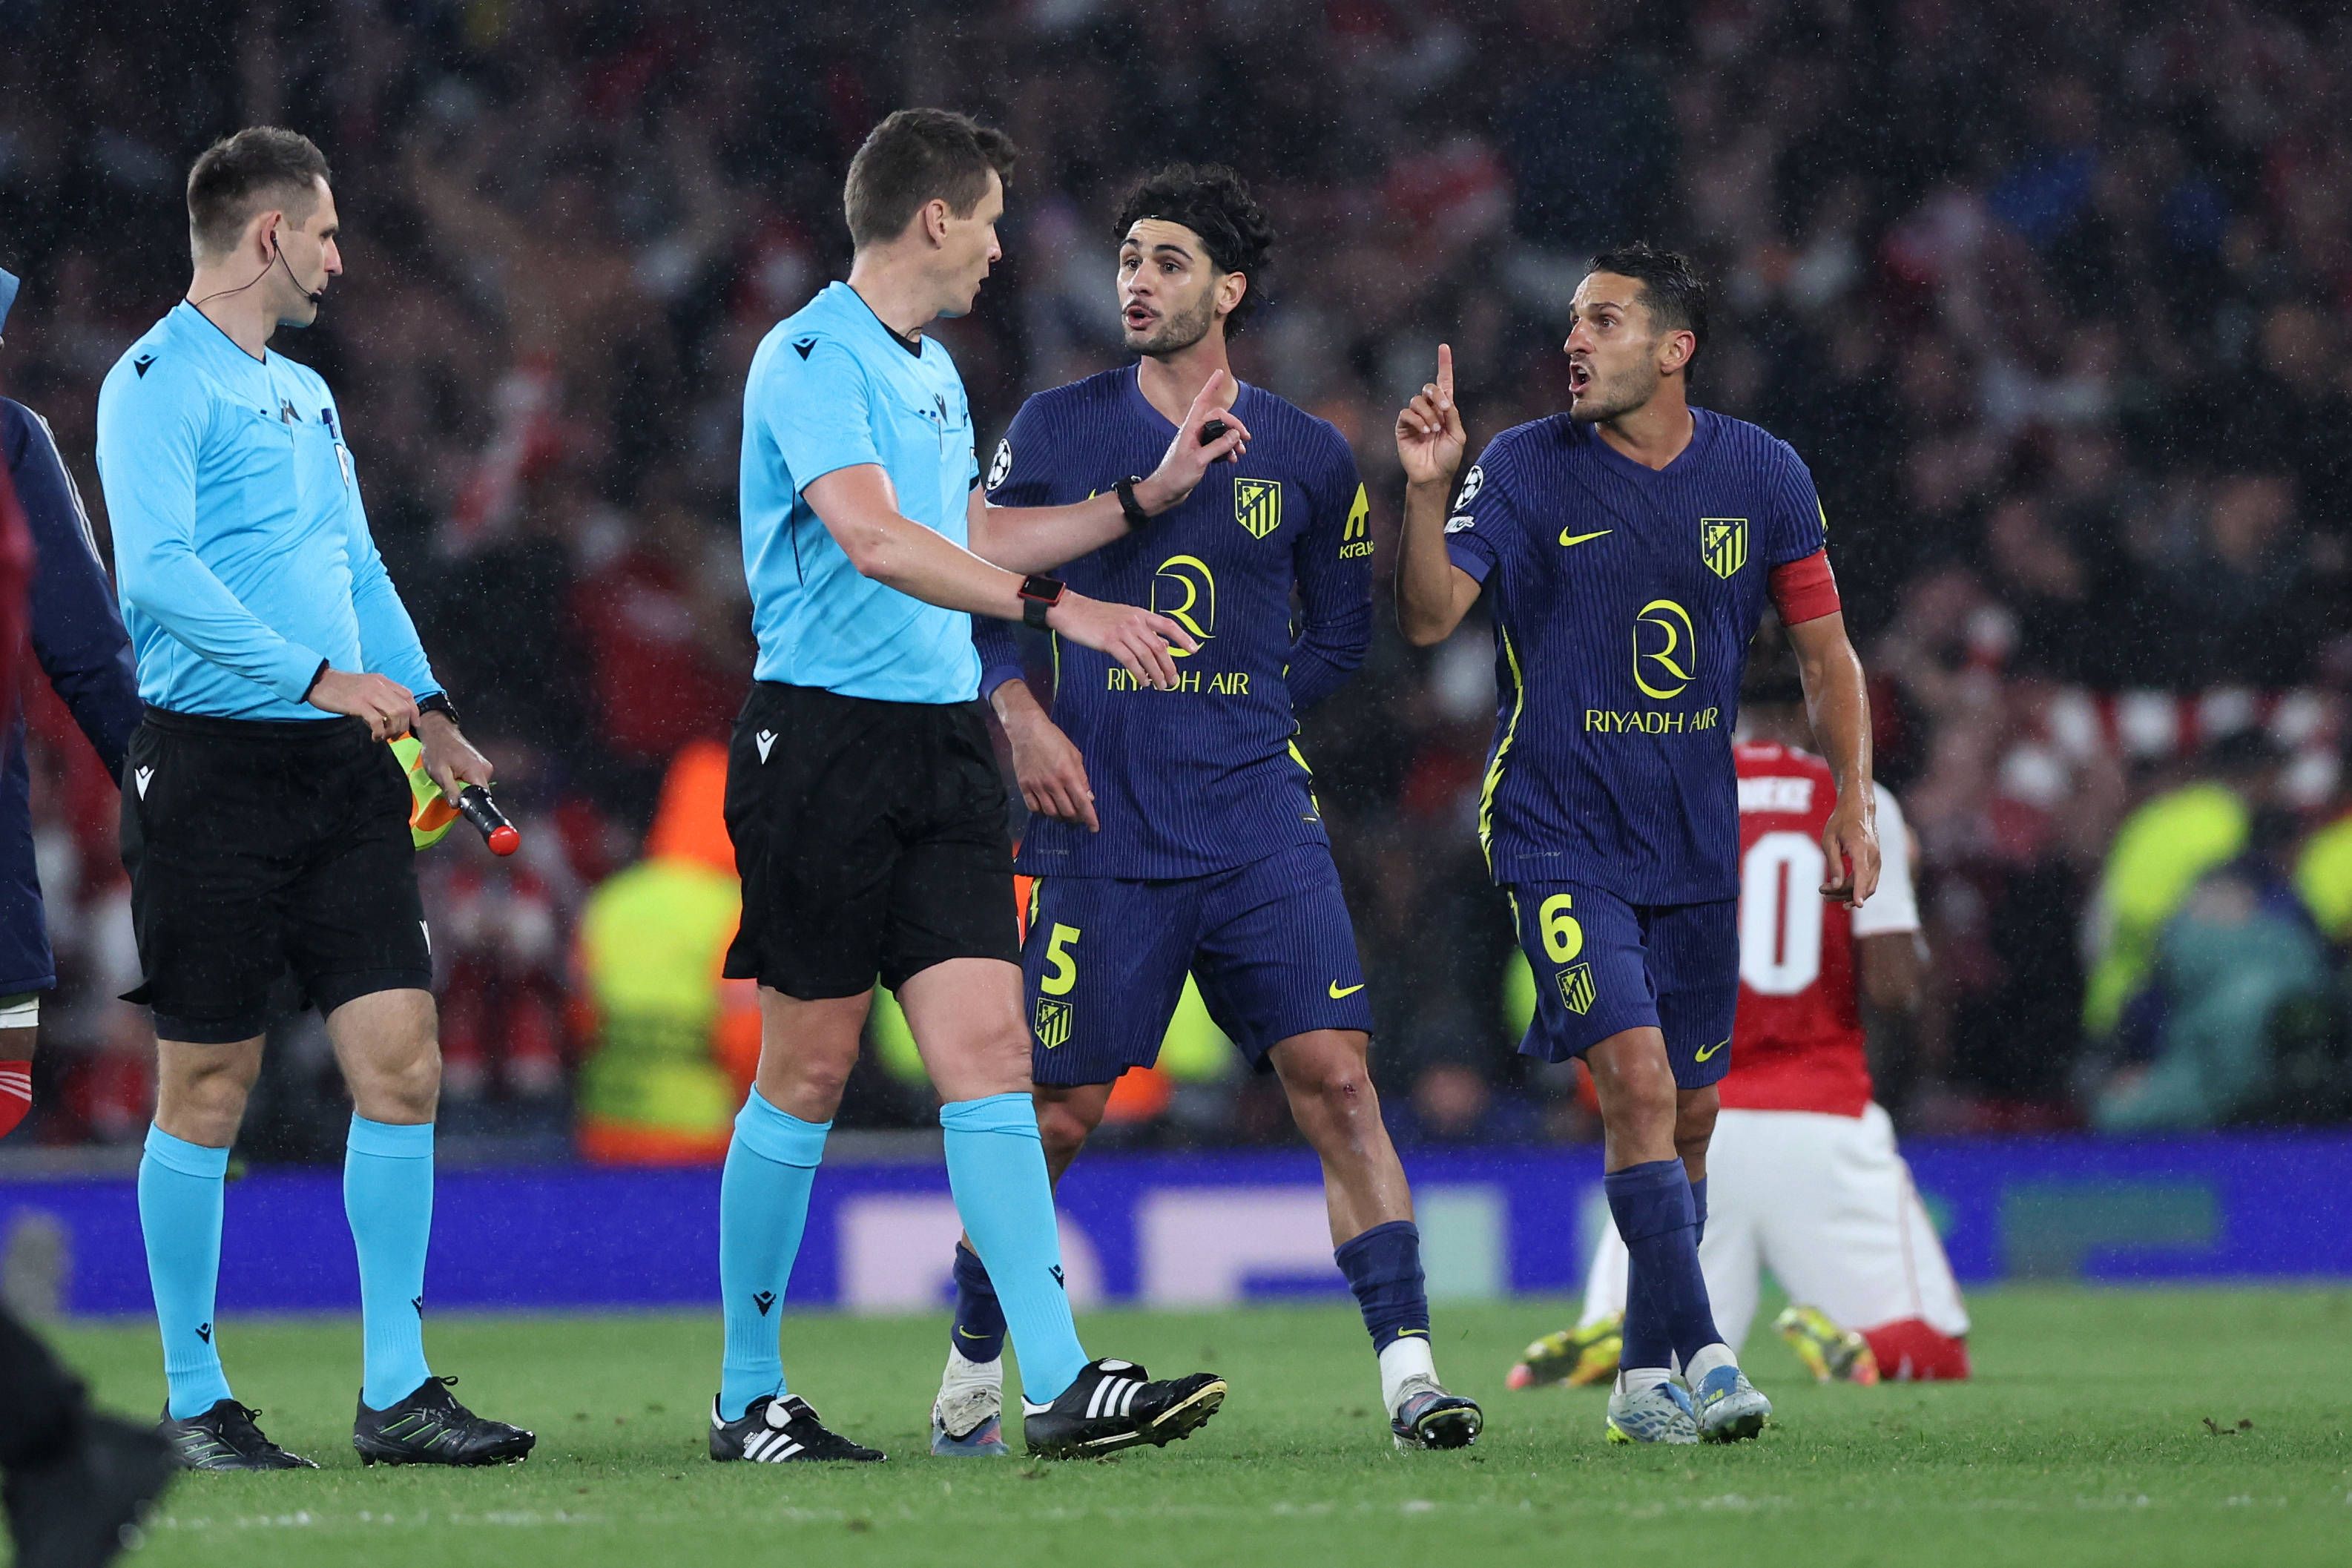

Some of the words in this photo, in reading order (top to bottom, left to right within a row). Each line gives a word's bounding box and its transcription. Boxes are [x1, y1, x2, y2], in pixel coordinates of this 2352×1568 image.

[1207, 672, 1249, 695] AIR
[1585, 709, 1684, 734] RIYADH
[1688, 707, 1719, 734] AIR
[1539, 893, 1584, 963] 6
[1041, 922, 1081, 995] 5
